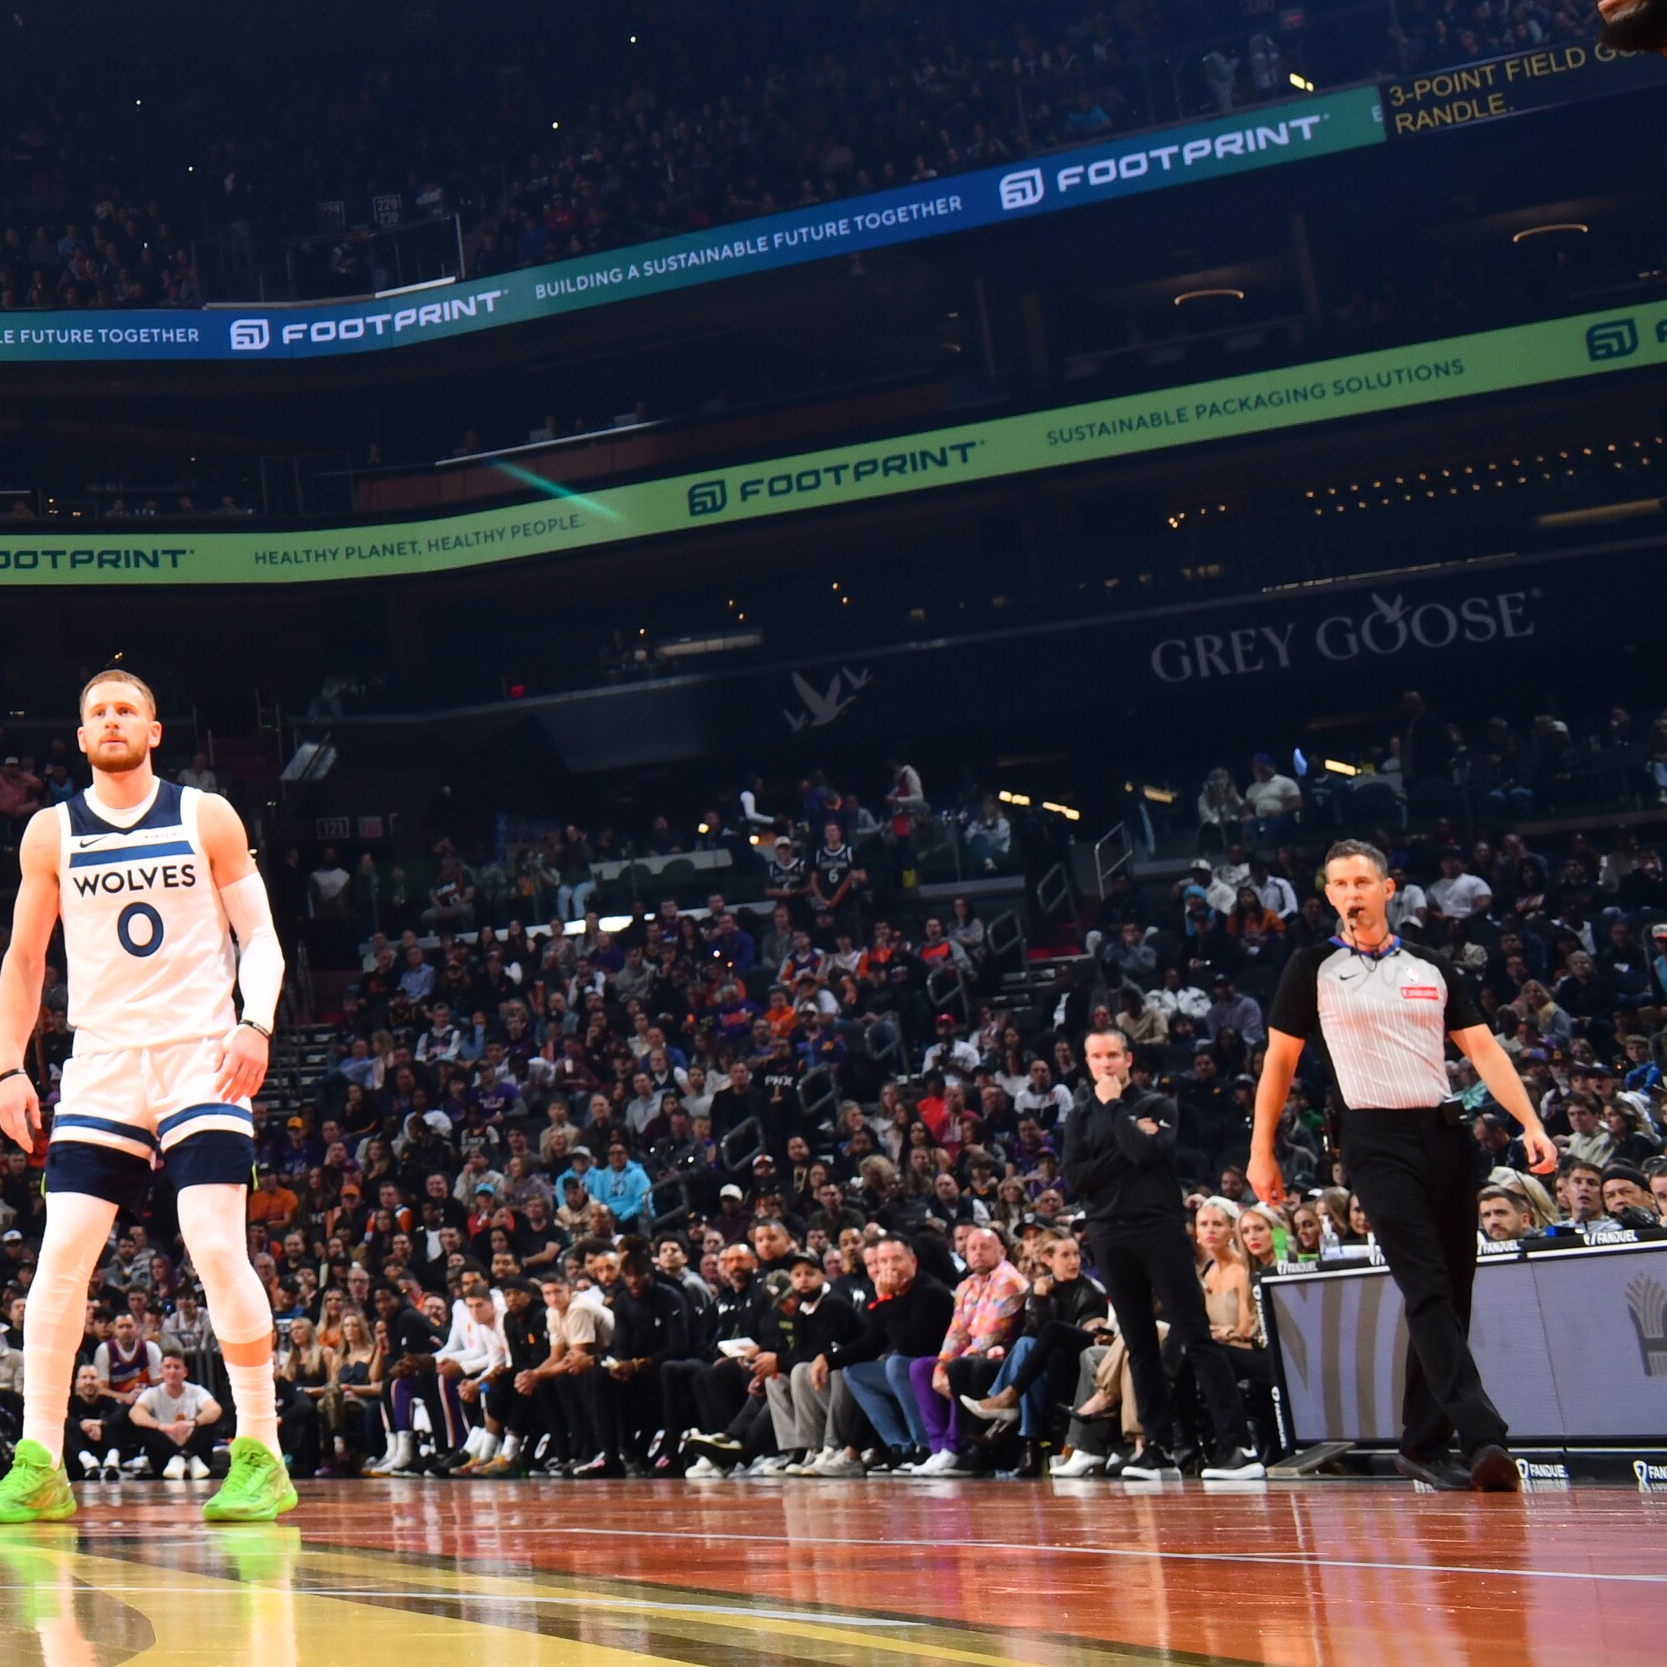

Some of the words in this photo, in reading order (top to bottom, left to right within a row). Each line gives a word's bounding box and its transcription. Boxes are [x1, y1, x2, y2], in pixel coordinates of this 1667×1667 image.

[1389, 64, 1498, 108] 3-POINT
[1506, 47, 1586, 91] FIELD
[1395, 93, 1515, 136] RANDLE.
[1057, 115, 1322, 192] FOOTPRINT
[535, 267, 622, 299] BUILDING
[627, 263, 641, 279] A
[643, 235, 770, 278] SUSTAINABLE
[774, 219, 851, 250] FUTURE
[853, 194, 962, 233] TOGETHER
[20, 329, 94, 344] FUTURE
[98, 328, 199, 343] TOGETHER
[282, 289, 502, 345] FOOTPRINT
[1047, 406, 1189, 446] SUSTAINABLE
[1195, 381, 1327, 422] PACKAGING
[1333, 358, 1465, 397] SOLUTIONS
[739, 441, 977, 502] FOOTPRINT
[254, 548, 338, 566] HEALTHY
[346, 541, 423, 560] PLANET,
[427, 527, 505, 553] HEALTHY
[1150, 623, 1295, 684] GREY
[1315, 589, 1536, 660] GOOSE
[72, 863, 197, 898] WOLVES
[117, 901, 164, 957] 0
[1483, 1239, 1521, 1253] FANDUEL
[1597, 1230, 1639, 1245] FANDUEL
